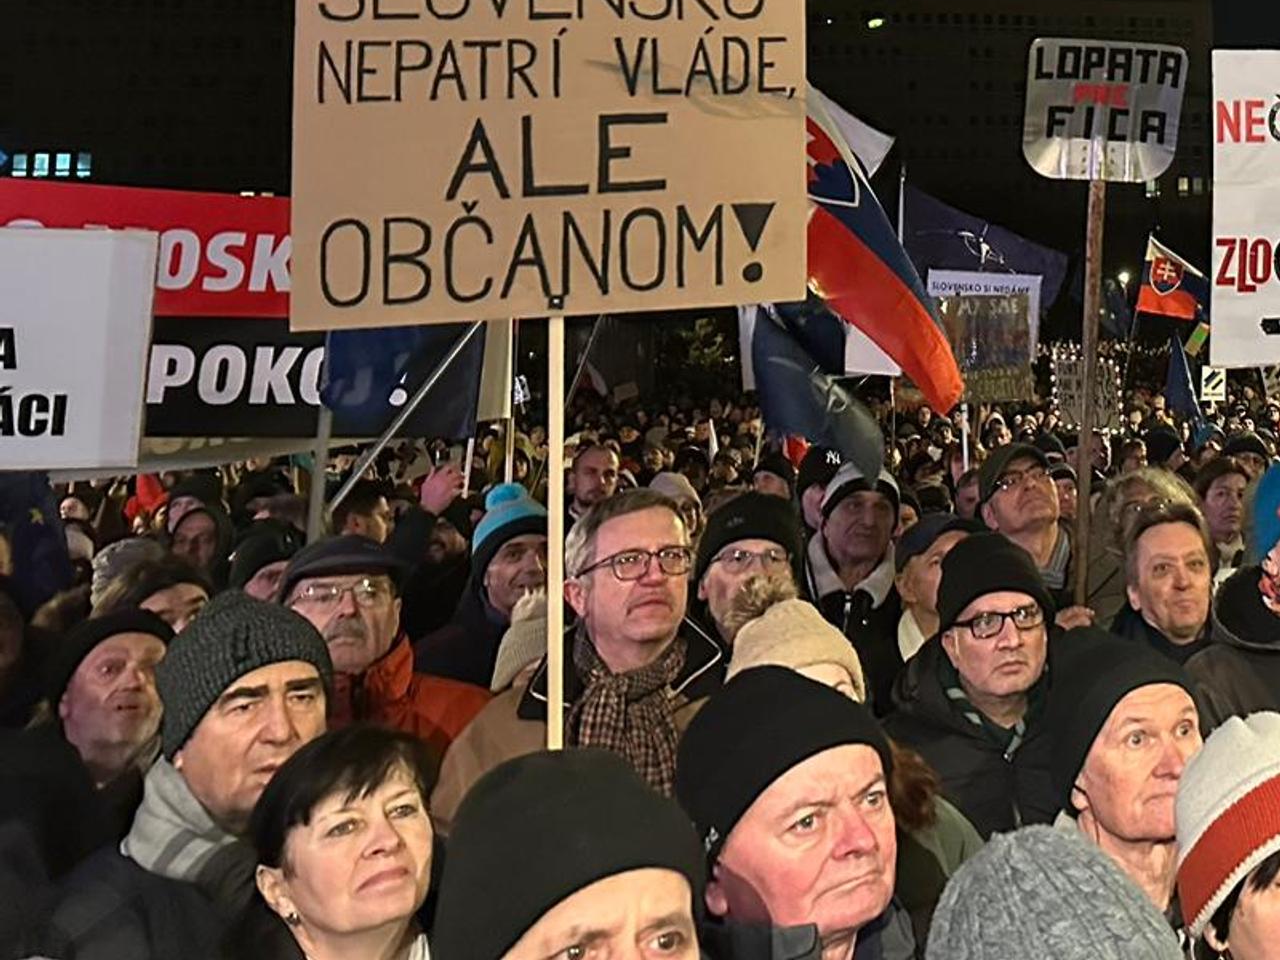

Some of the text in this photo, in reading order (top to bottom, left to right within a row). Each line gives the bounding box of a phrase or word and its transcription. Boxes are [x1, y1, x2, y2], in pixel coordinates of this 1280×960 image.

[317, 25, 797, 104] NEPATRÍ VLÁDE,
[1034, 45, 1183, 89] LOPATA
[444, 111, 669, 201] ALE
[1046, 105, 1167, 145] FICA
[319, 200, 776, 308] OBČANOM!
